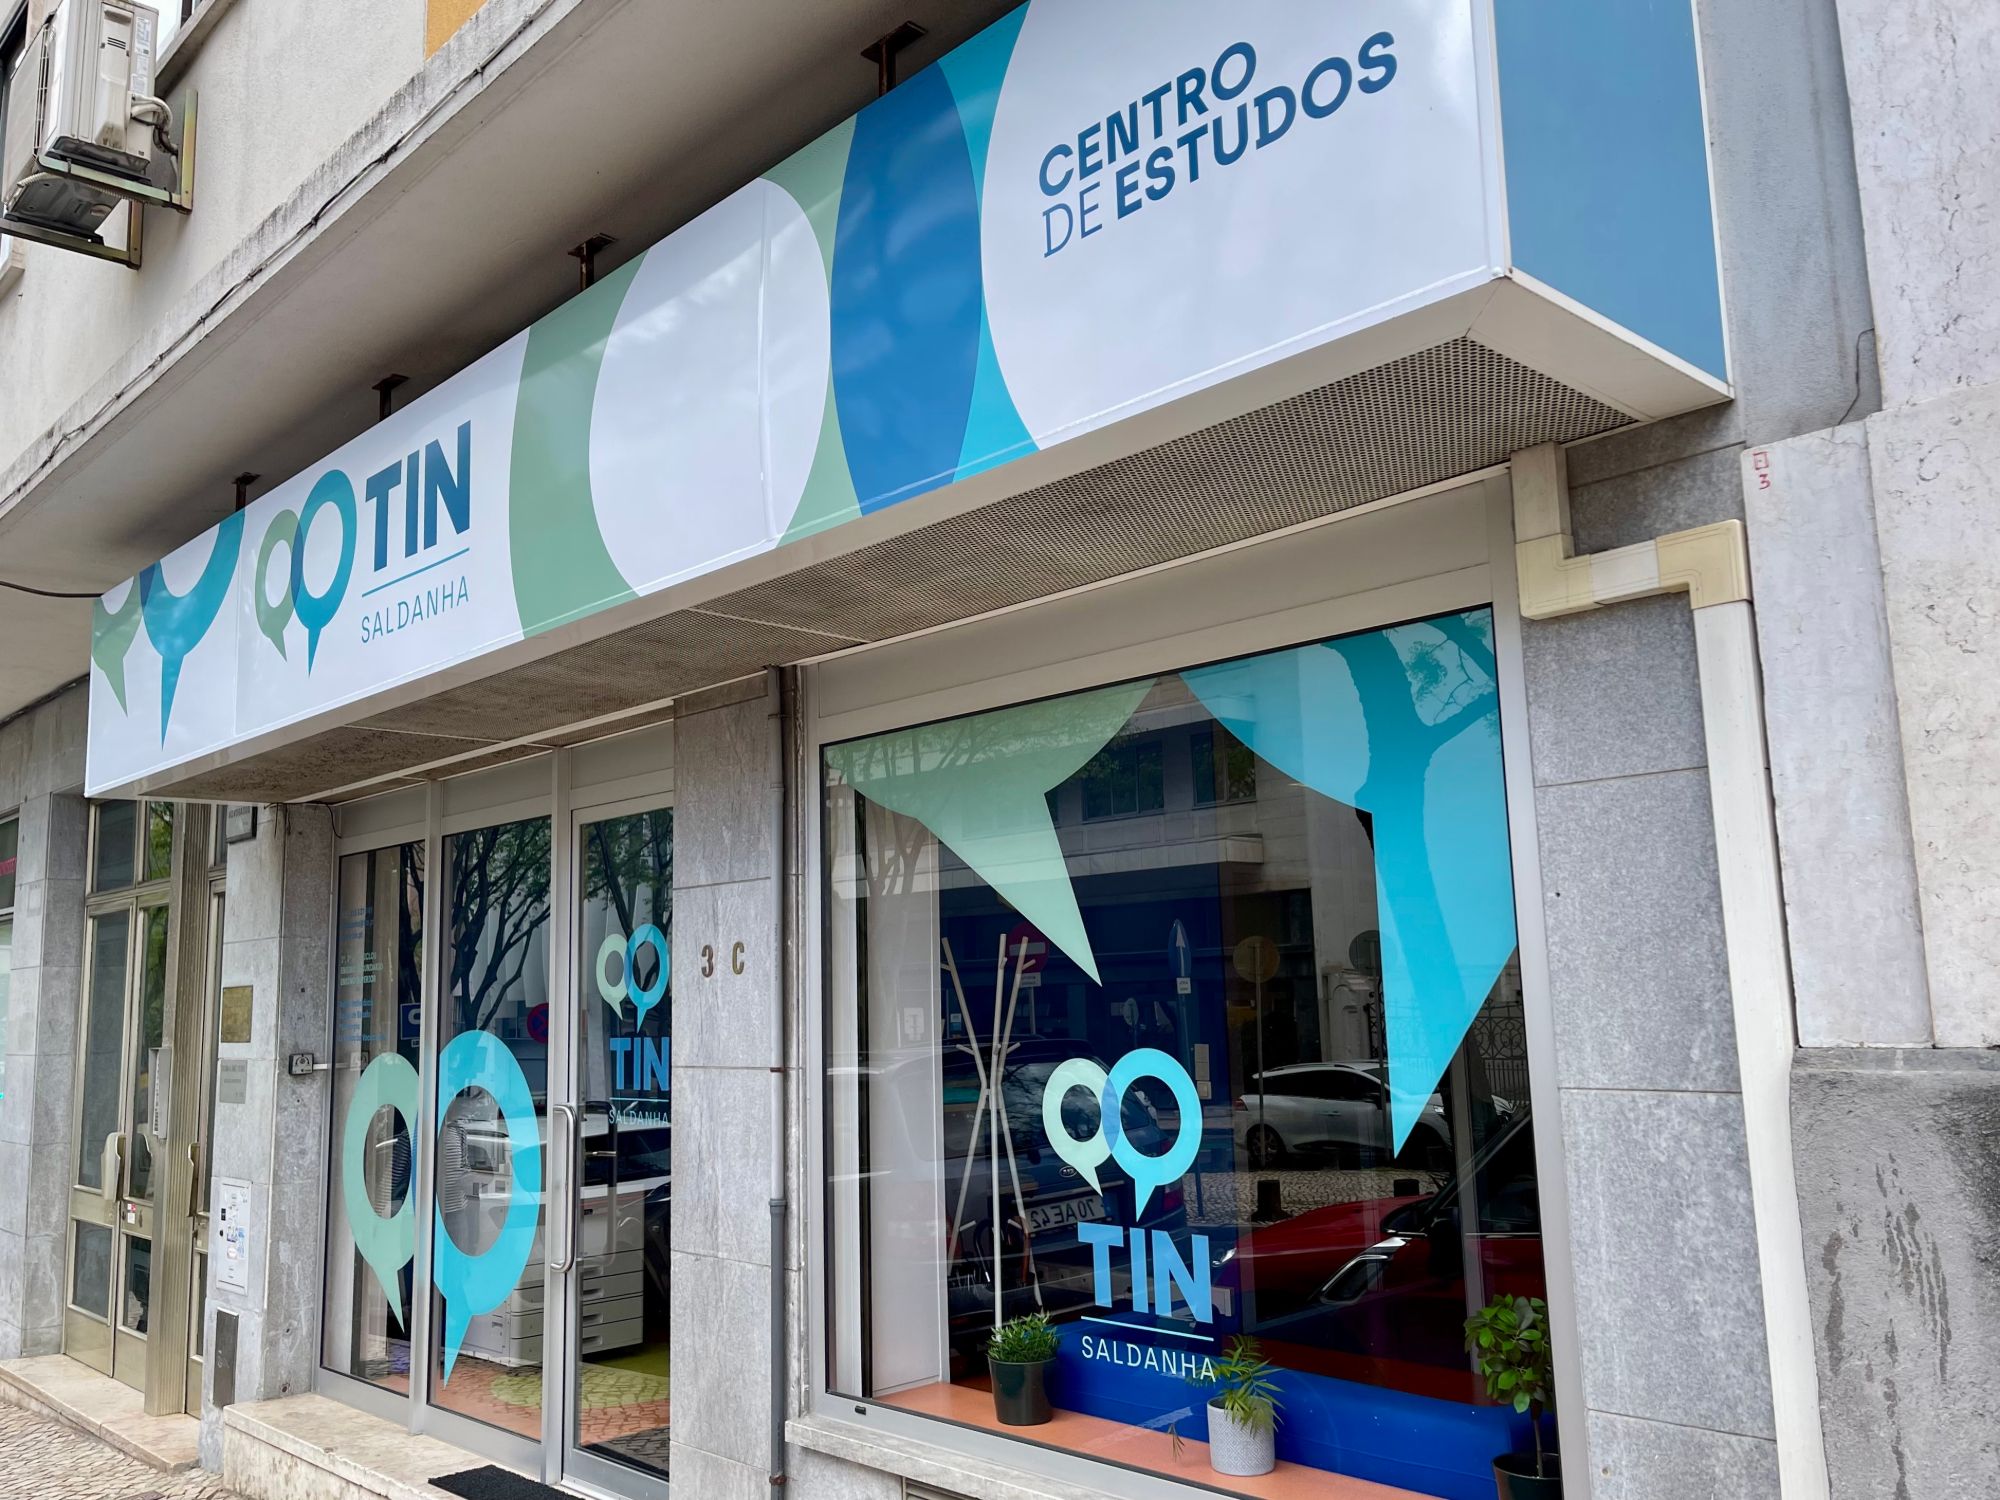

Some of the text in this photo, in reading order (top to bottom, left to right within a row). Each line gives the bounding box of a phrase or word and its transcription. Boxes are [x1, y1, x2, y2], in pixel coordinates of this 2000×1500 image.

[1039, 41, 1257, 197] CENTRO
[1042, 31, 1398, 259] DE ESTUDOS
[364, 419, 471, 572] TIN
[361, 575, 470, 644] SALDANHA
[701, 944, 714, 978] 3
[732, 941, 745, 975] C
[609, 1036, 670, 1091] TIN
[608, 1109, 669, 1126] SALDANHA
[1077, 1221, 1214, 1324] TIN
[1081, 1335, 1217, 1383] SALDANHA
